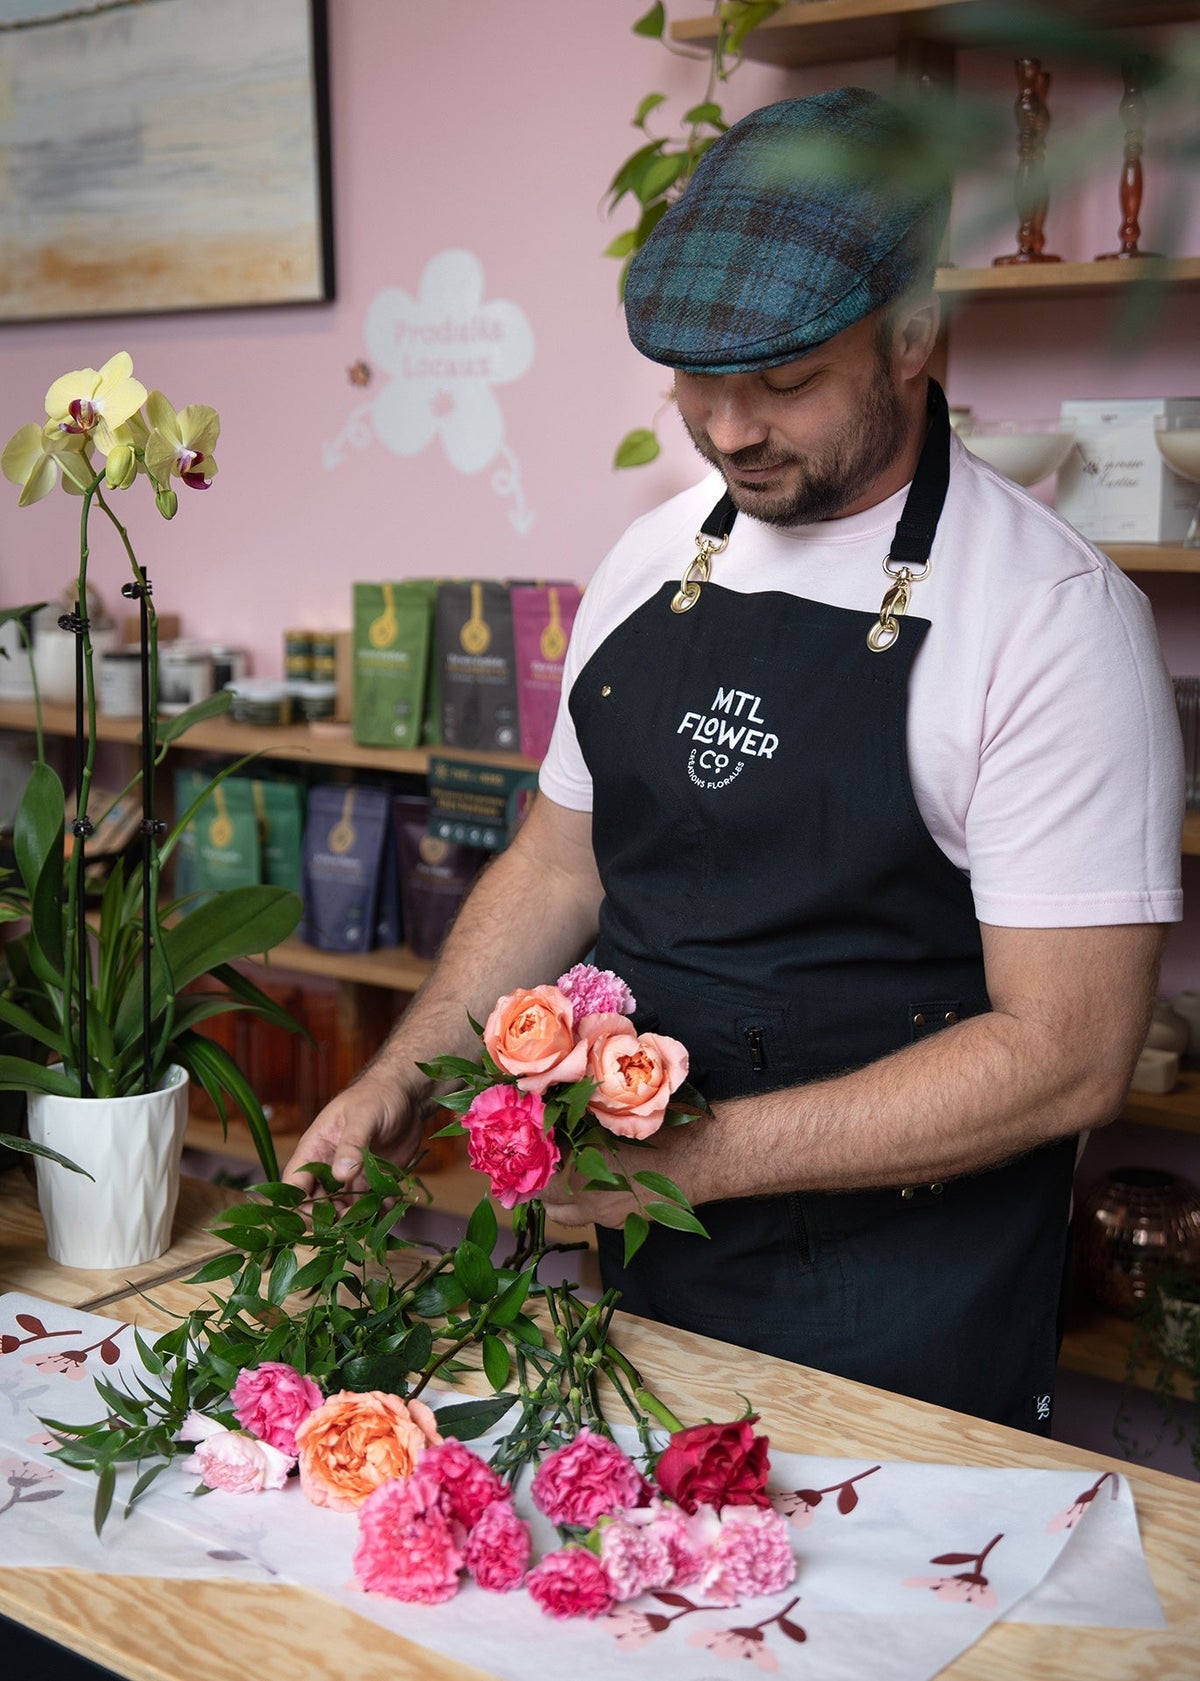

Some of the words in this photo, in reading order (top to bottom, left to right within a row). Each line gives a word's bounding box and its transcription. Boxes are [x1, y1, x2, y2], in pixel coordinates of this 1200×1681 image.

[711, 687, 764, 724] MTL
[677, 712, 779, 759] FLOWER
[707, 761, 745, 789] FLORALES
